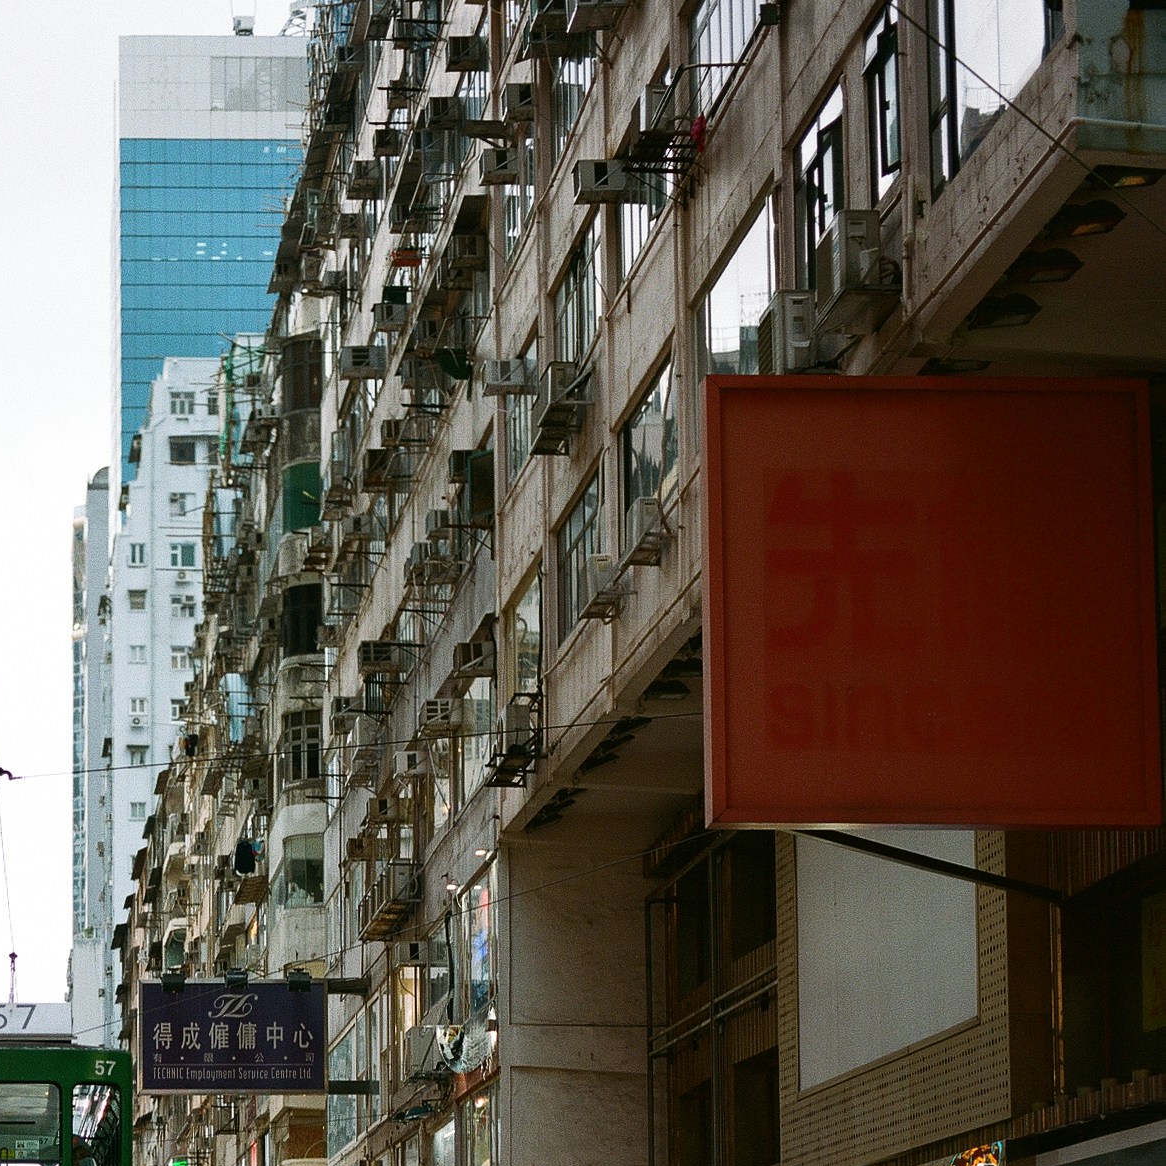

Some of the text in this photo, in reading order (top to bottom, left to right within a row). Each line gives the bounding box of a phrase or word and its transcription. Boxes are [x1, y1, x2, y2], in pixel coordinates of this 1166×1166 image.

[152, 1021, 314, 1050] 得成僱傭中心
[94, 1060, 116, 1076] 57
[153, 1067, 184, 1080] TECHNIC
[186, 1067, 236, 1082] Employment
[238, 1067, 269, 1080] Service
[271, 1067, 297, 1080] Centre
